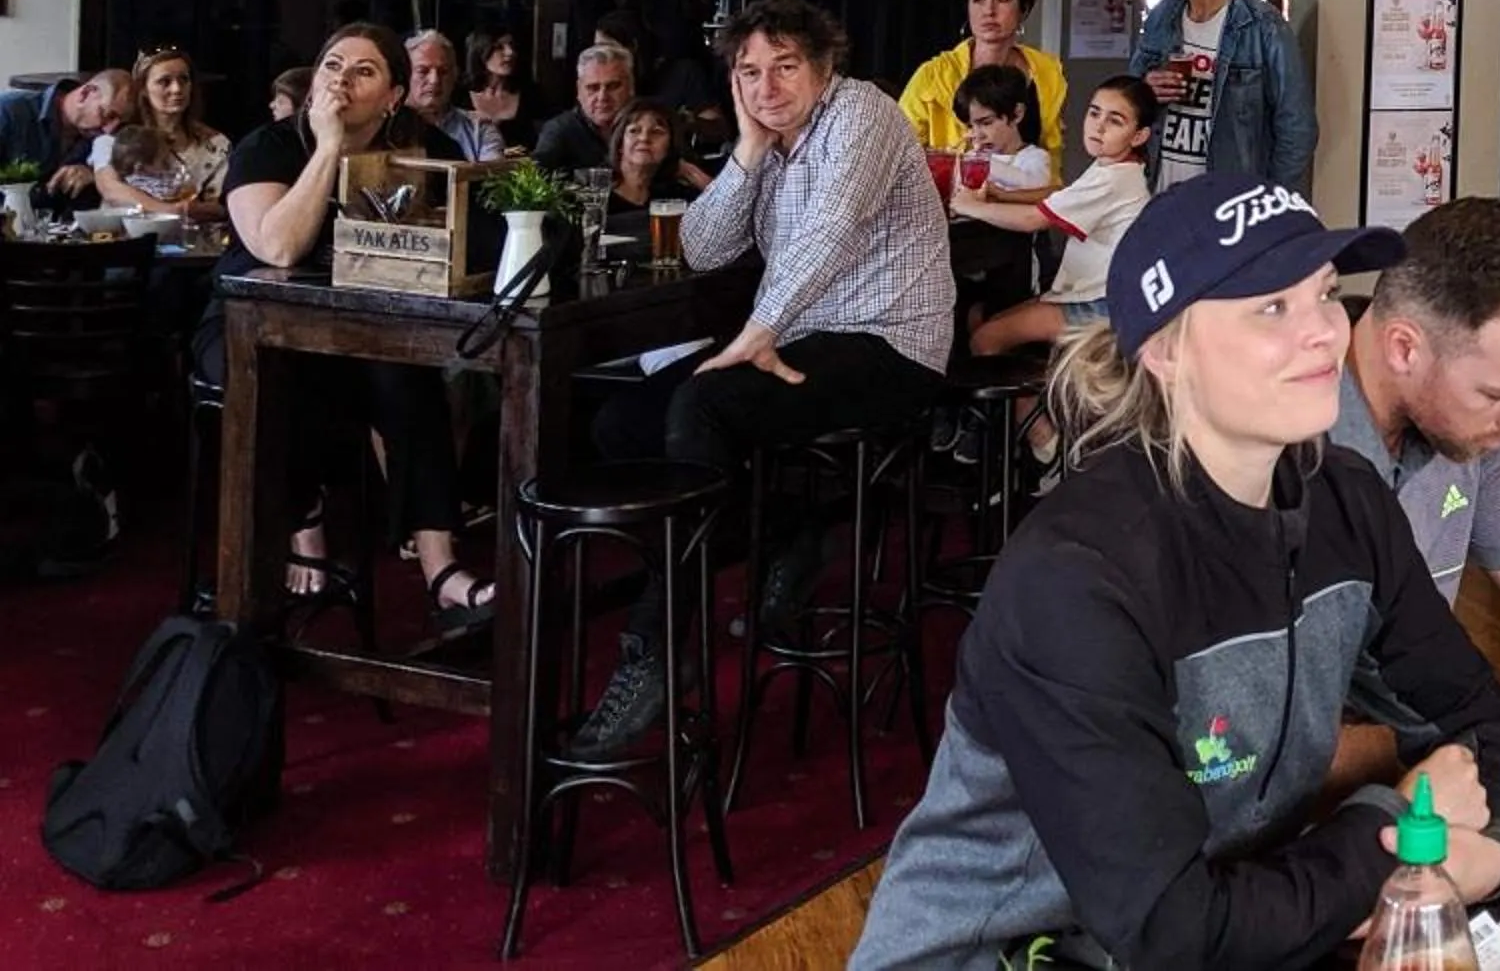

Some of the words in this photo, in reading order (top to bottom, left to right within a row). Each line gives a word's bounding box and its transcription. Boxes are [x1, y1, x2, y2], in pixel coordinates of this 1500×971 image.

[353, 228, 386, 247] YAK
[388, 231, 431, 253] ALES
[1215, 184, 1319, 246] Title
[1141, 258, 1175, 312] FJ
